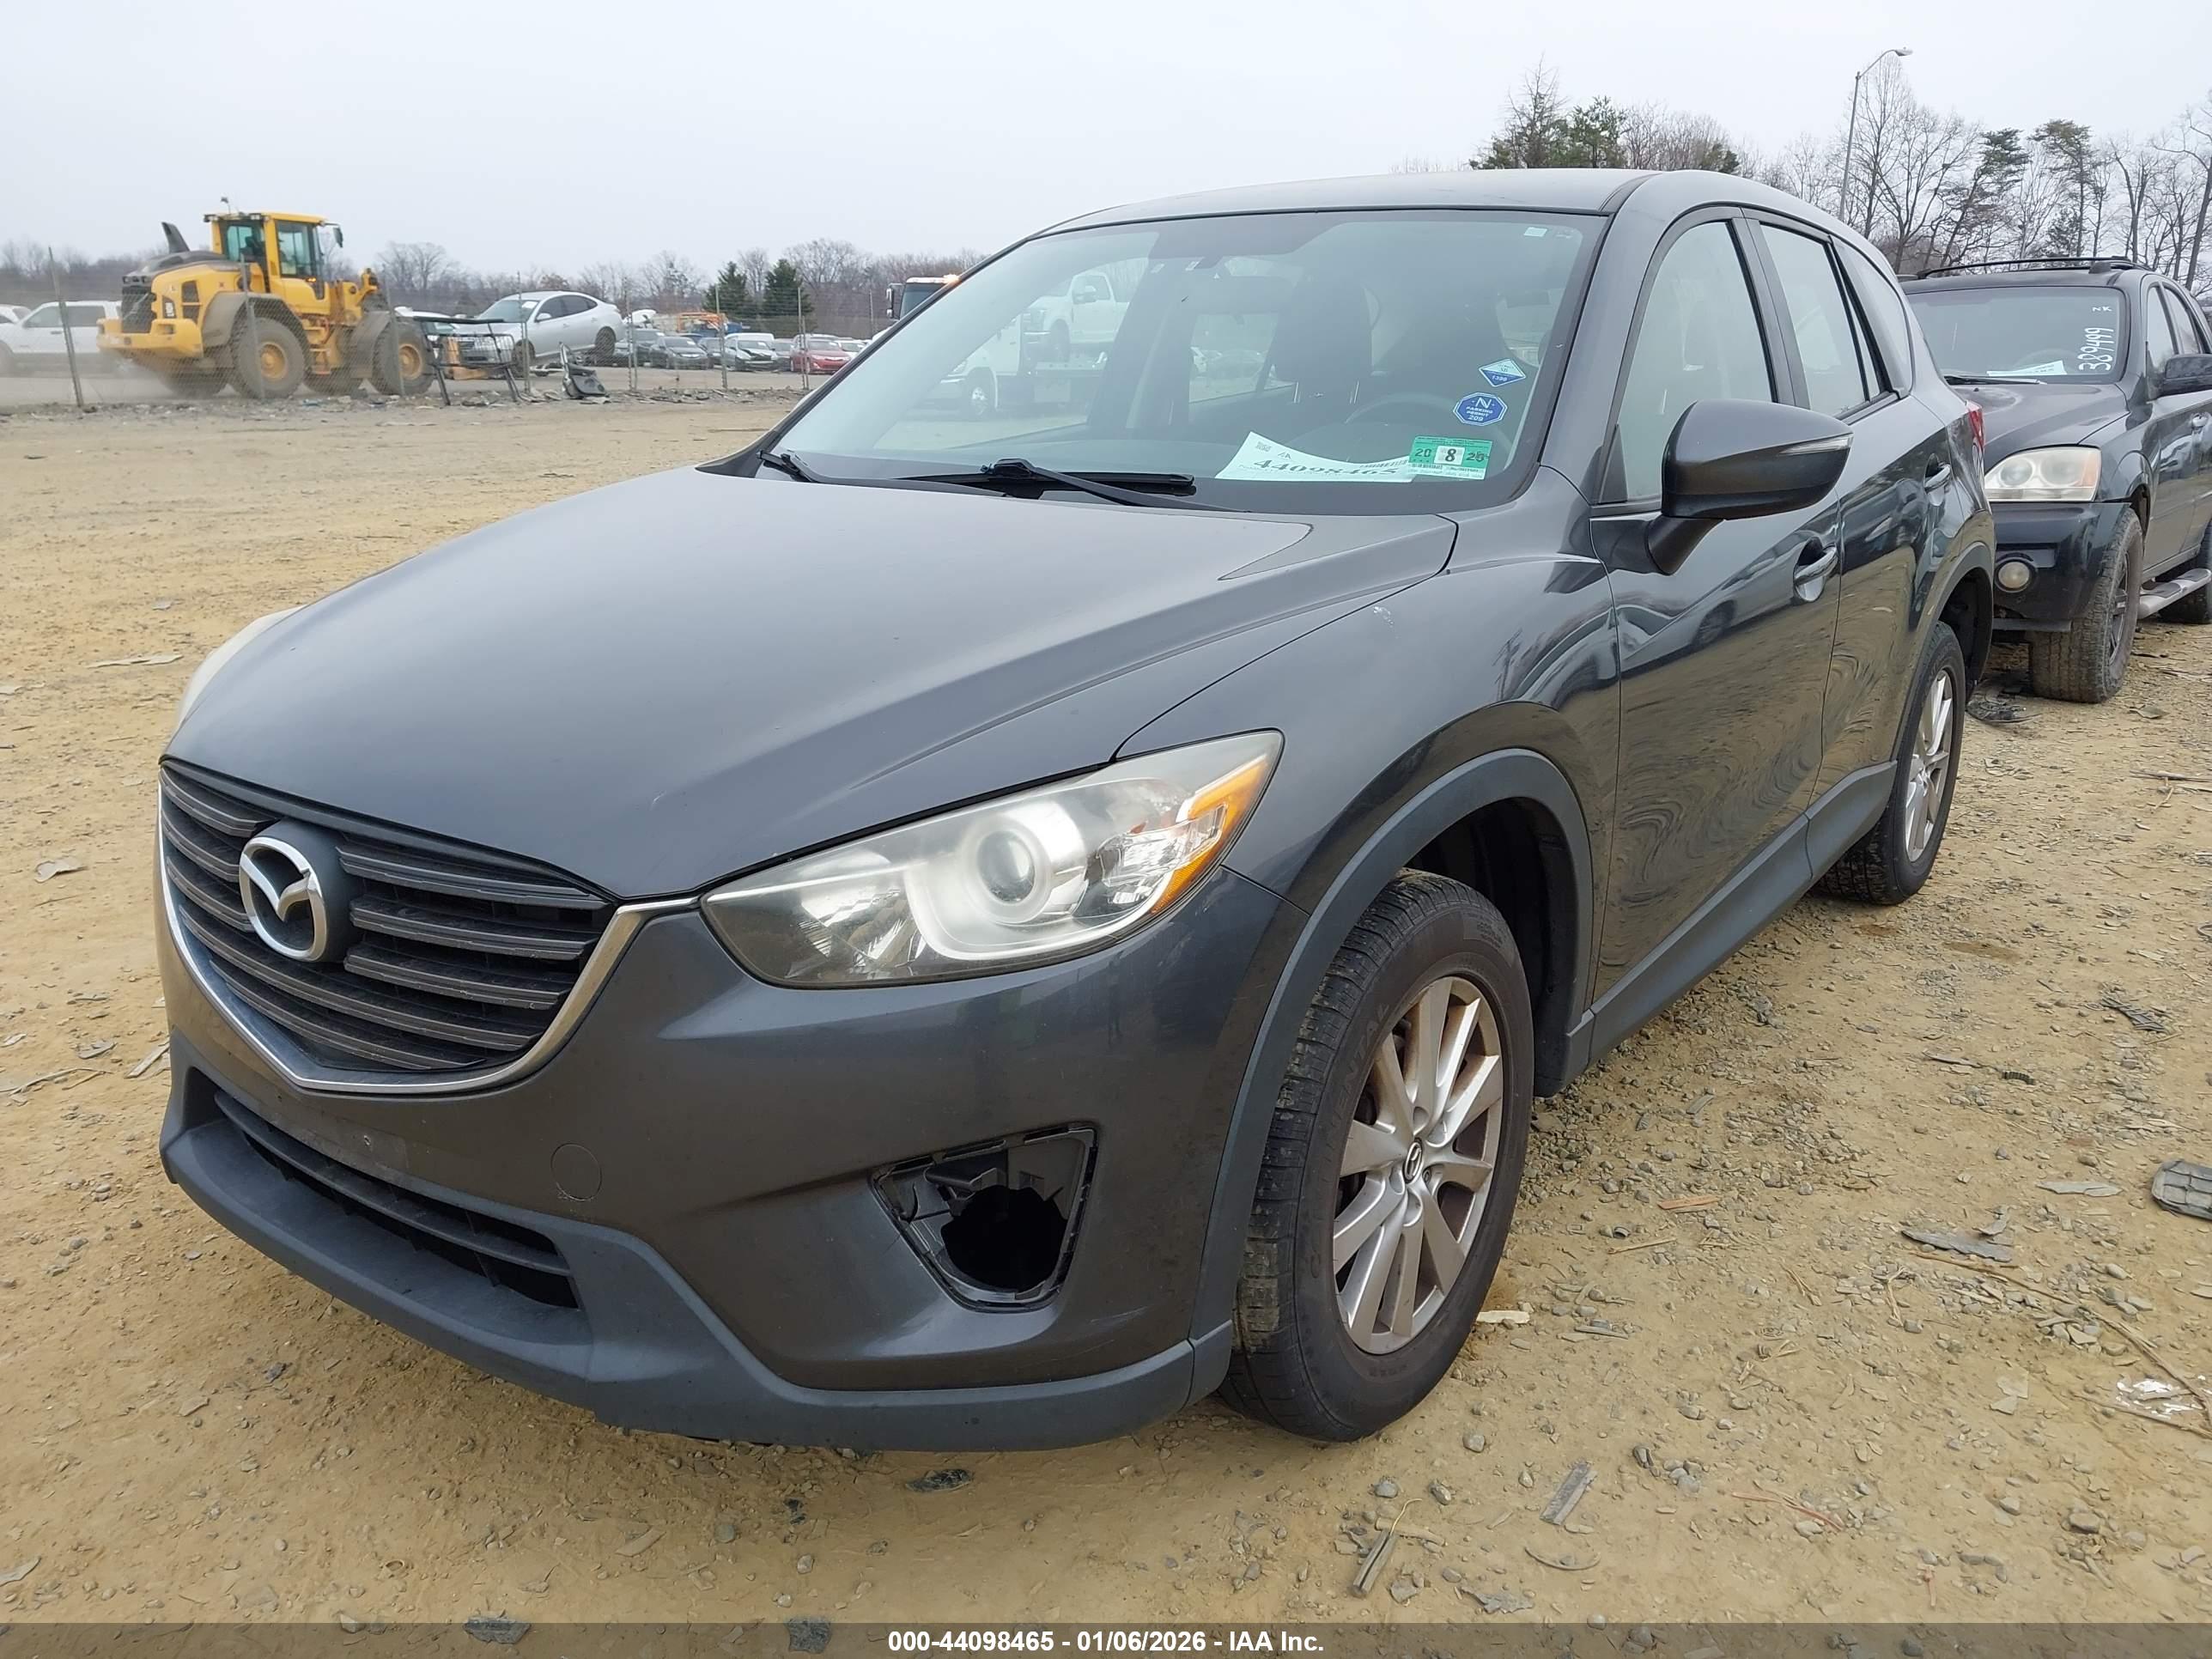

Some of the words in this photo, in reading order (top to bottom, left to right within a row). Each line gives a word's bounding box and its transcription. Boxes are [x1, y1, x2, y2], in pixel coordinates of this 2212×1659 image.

[2077, 327, 2114, 371] 389499
[1465, 405, 1494, 414] PARKING
[1414, 447, 1432, 458] 20
[1444, 448, 1457, 462] 8
